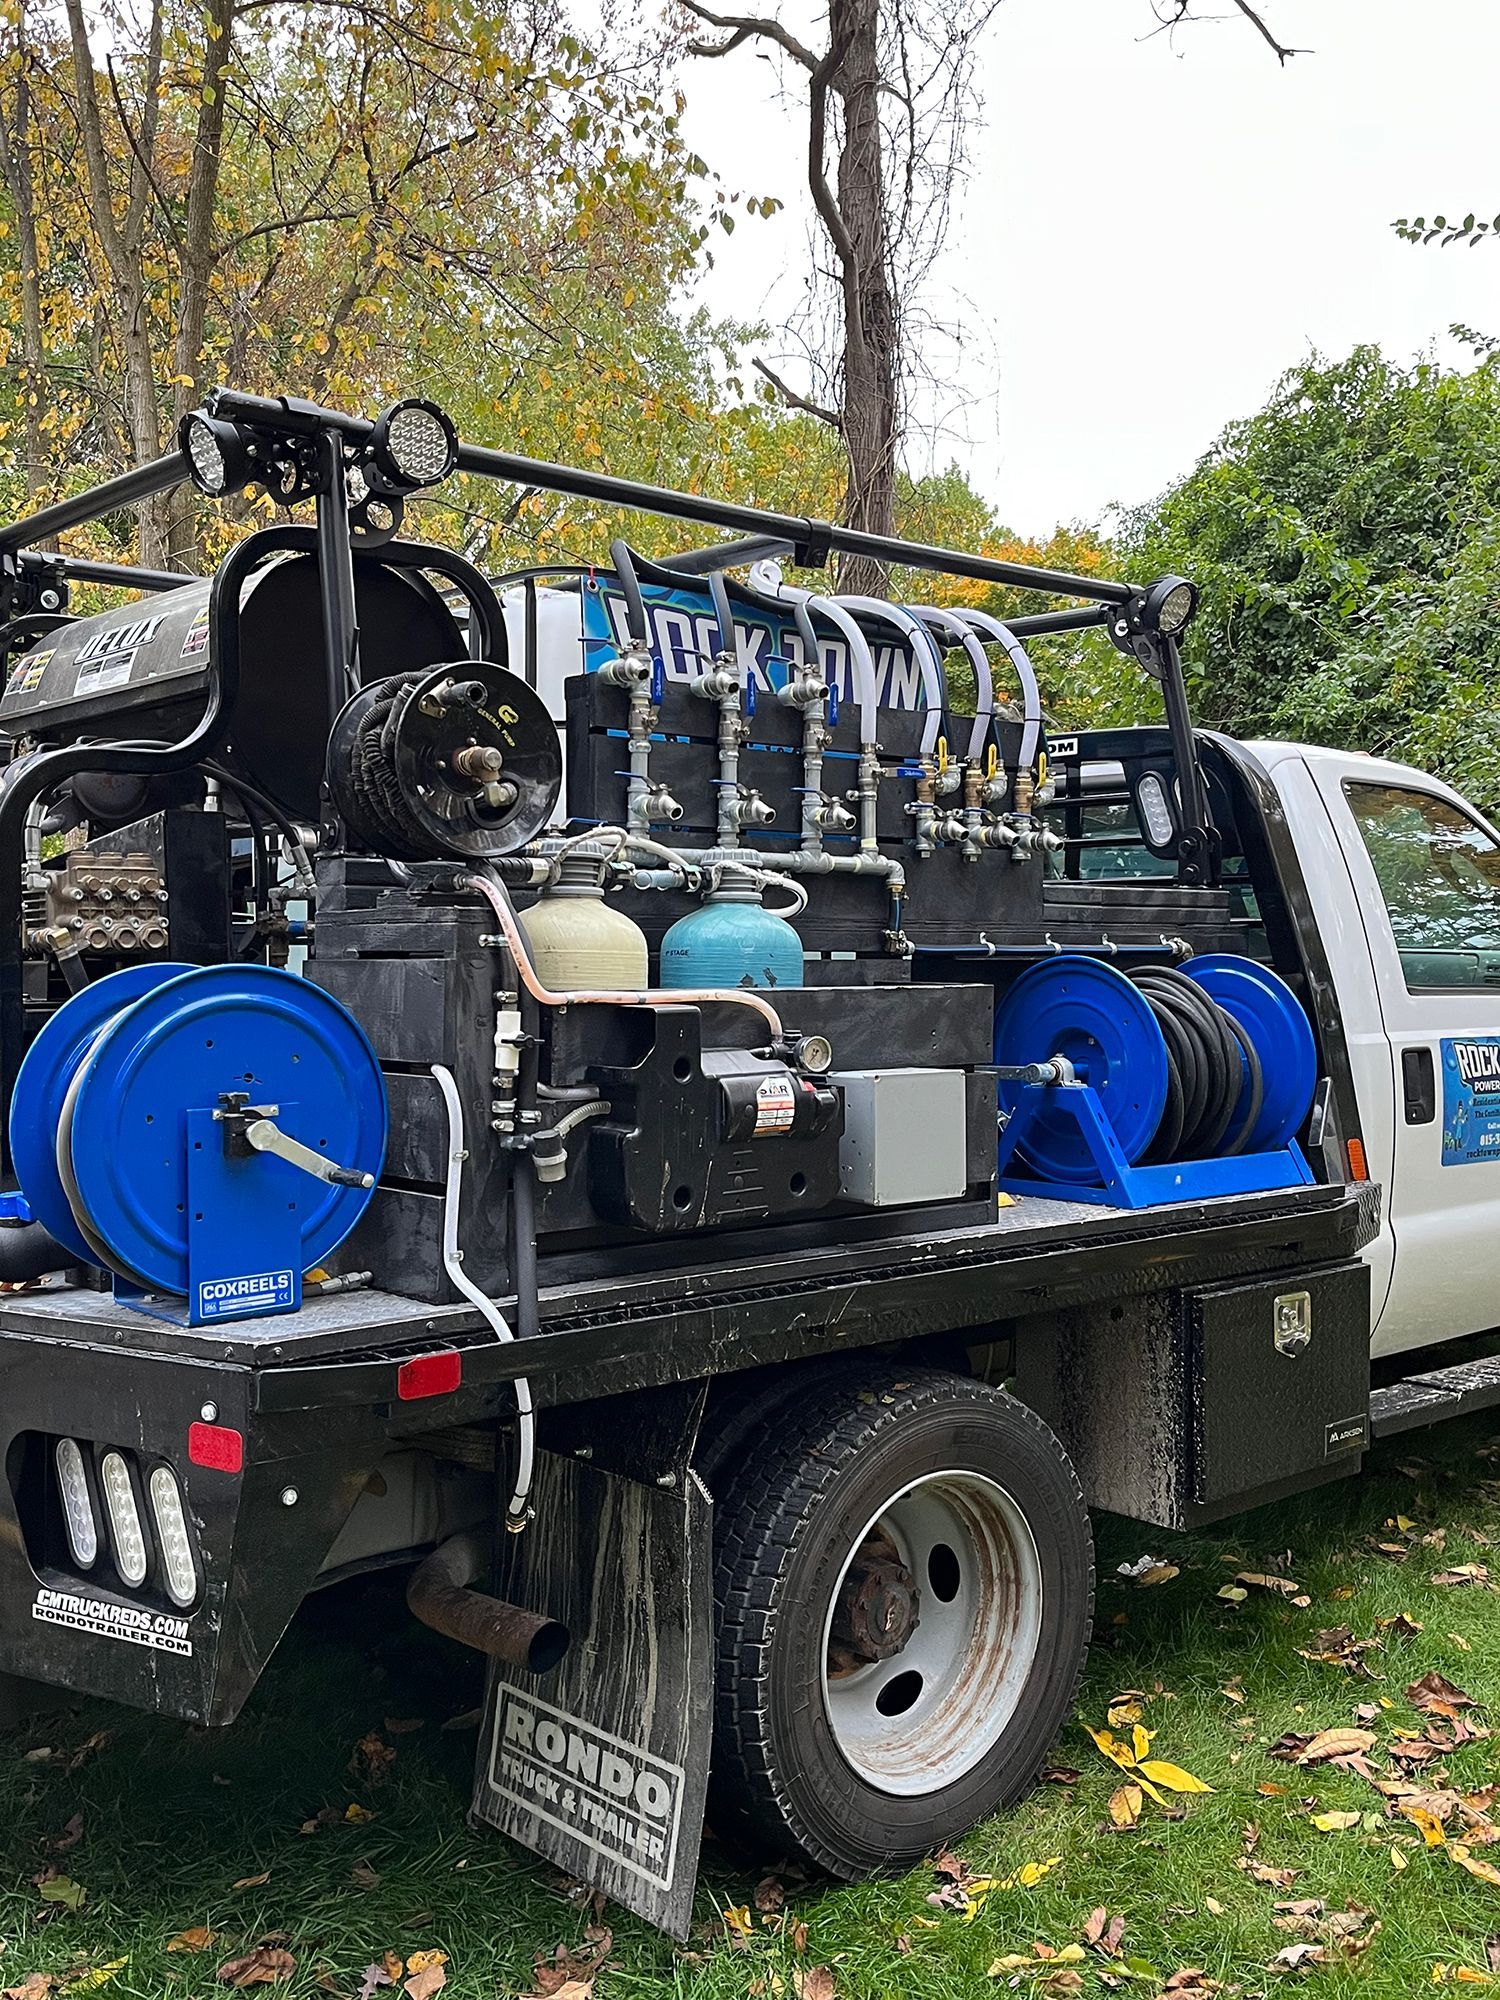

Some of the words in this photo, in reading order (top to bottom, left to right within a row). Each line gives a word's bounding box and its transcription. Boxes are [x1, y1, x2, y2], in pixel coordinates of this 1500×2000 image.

[477, 708, 501, 730] GENERAL
[501, 729, 516, 747] PUMP
[1454, 1043, 1500, 1080] ROCK
[203, 1275, 289, 1300] COXREELS
[35, 1608, 189, 1653] RONDOTRAILER.COM
[36, 1589, 189, 1639] CMTRUCKBEDS.COM
[505, 1702, 670, 1818] RONDO
[501, 1753, 560, 1805] TRUCK
[561, 1788, 576, 1814] &
[580, 1796, 665, 1863] TRAILER
